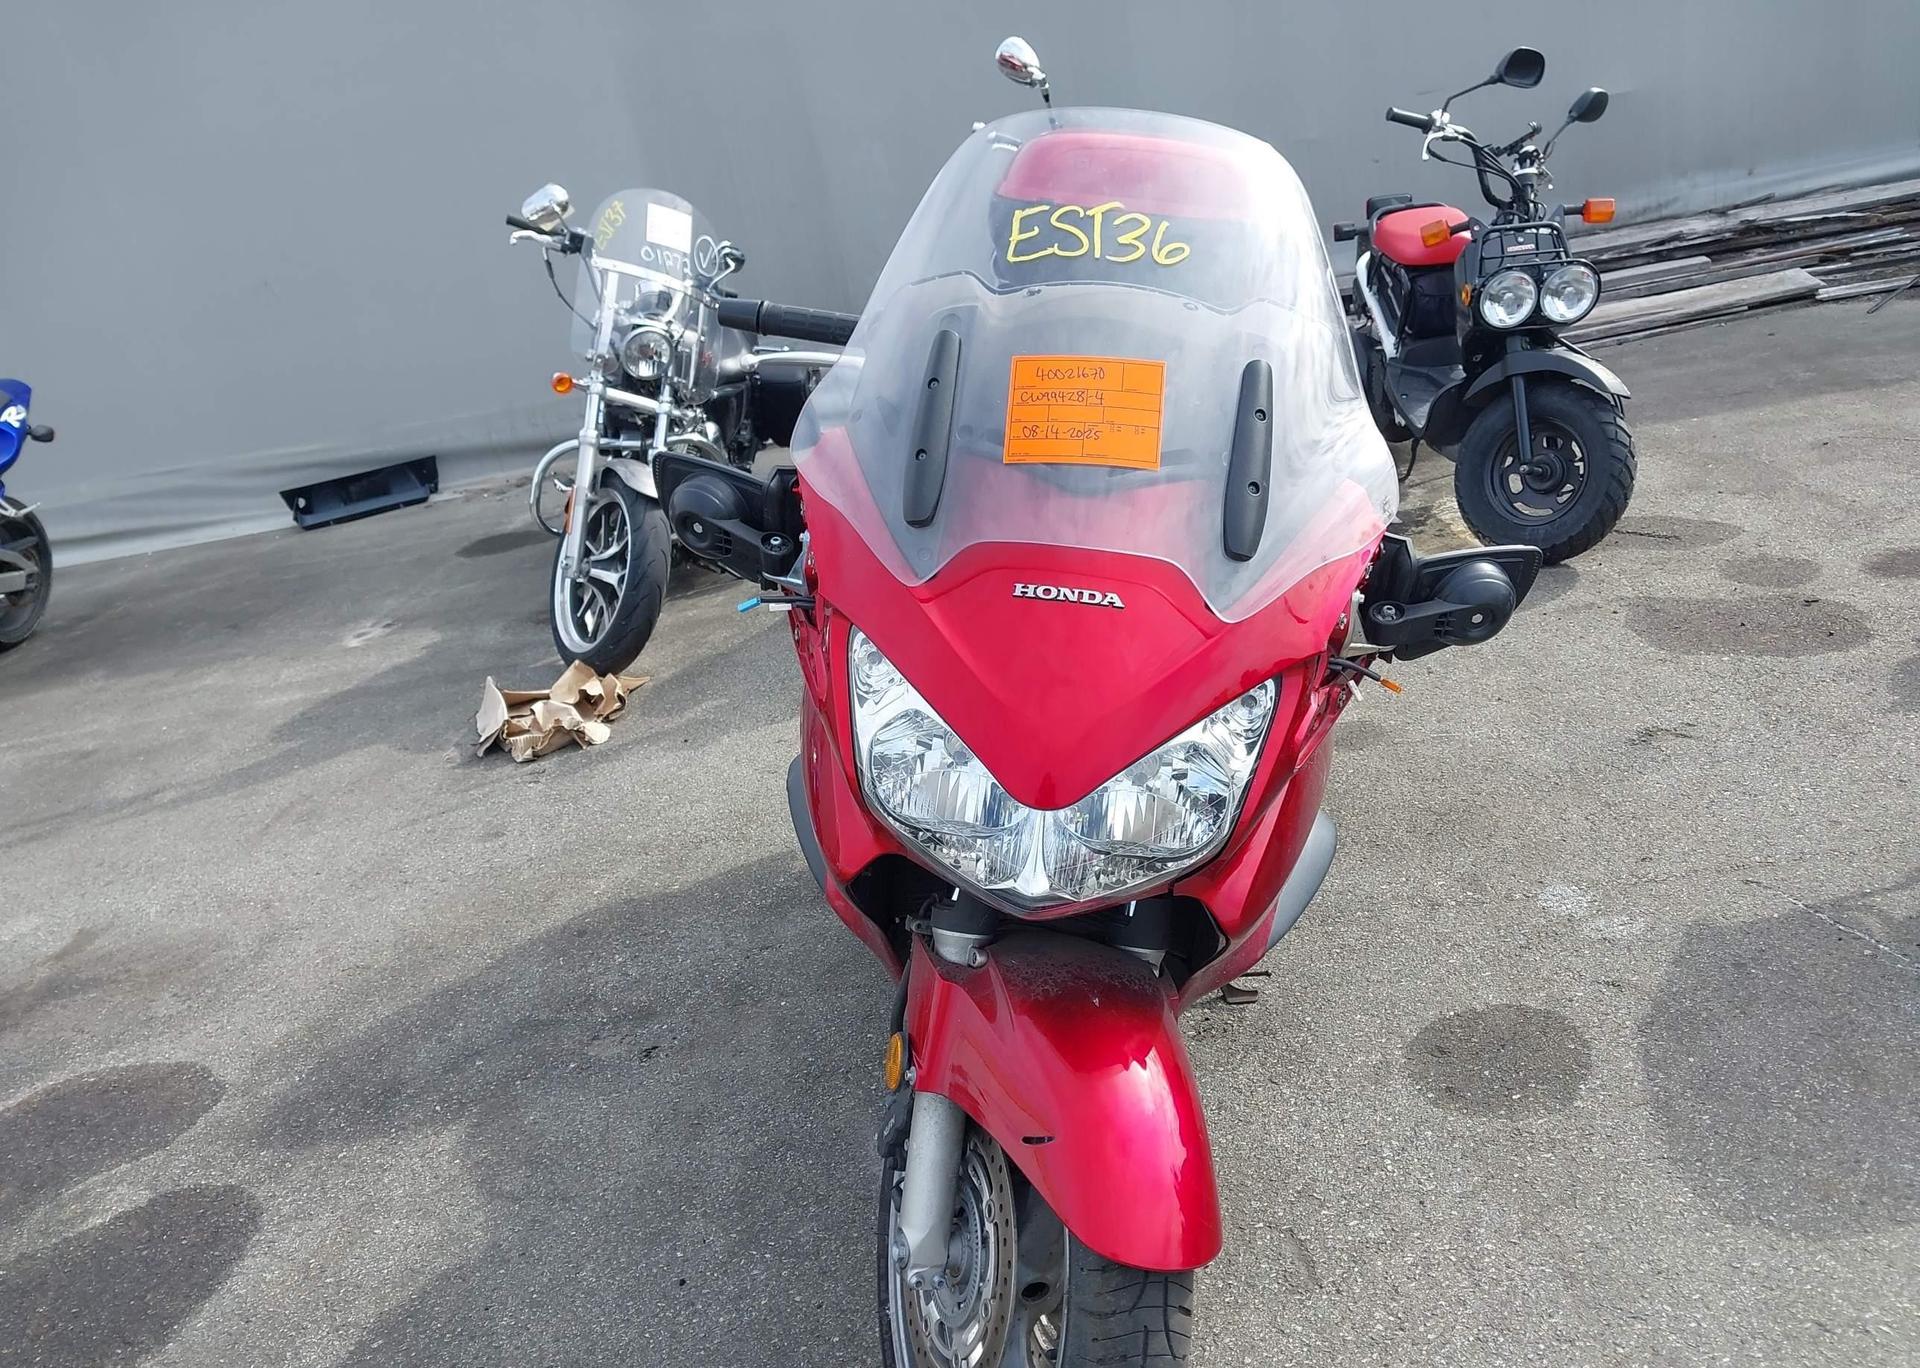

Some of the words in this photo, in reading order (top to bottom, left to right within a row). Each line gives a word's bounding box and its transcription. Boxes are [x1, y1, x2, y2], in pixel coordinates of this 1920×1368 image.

[1006, 200, 1191, 265] EST36
[1035, 365, 1105, 381] 40021670
[1022, 424, 1103, 441] 08-14-2025
[1012, 583, 1125, 609] HONDA
